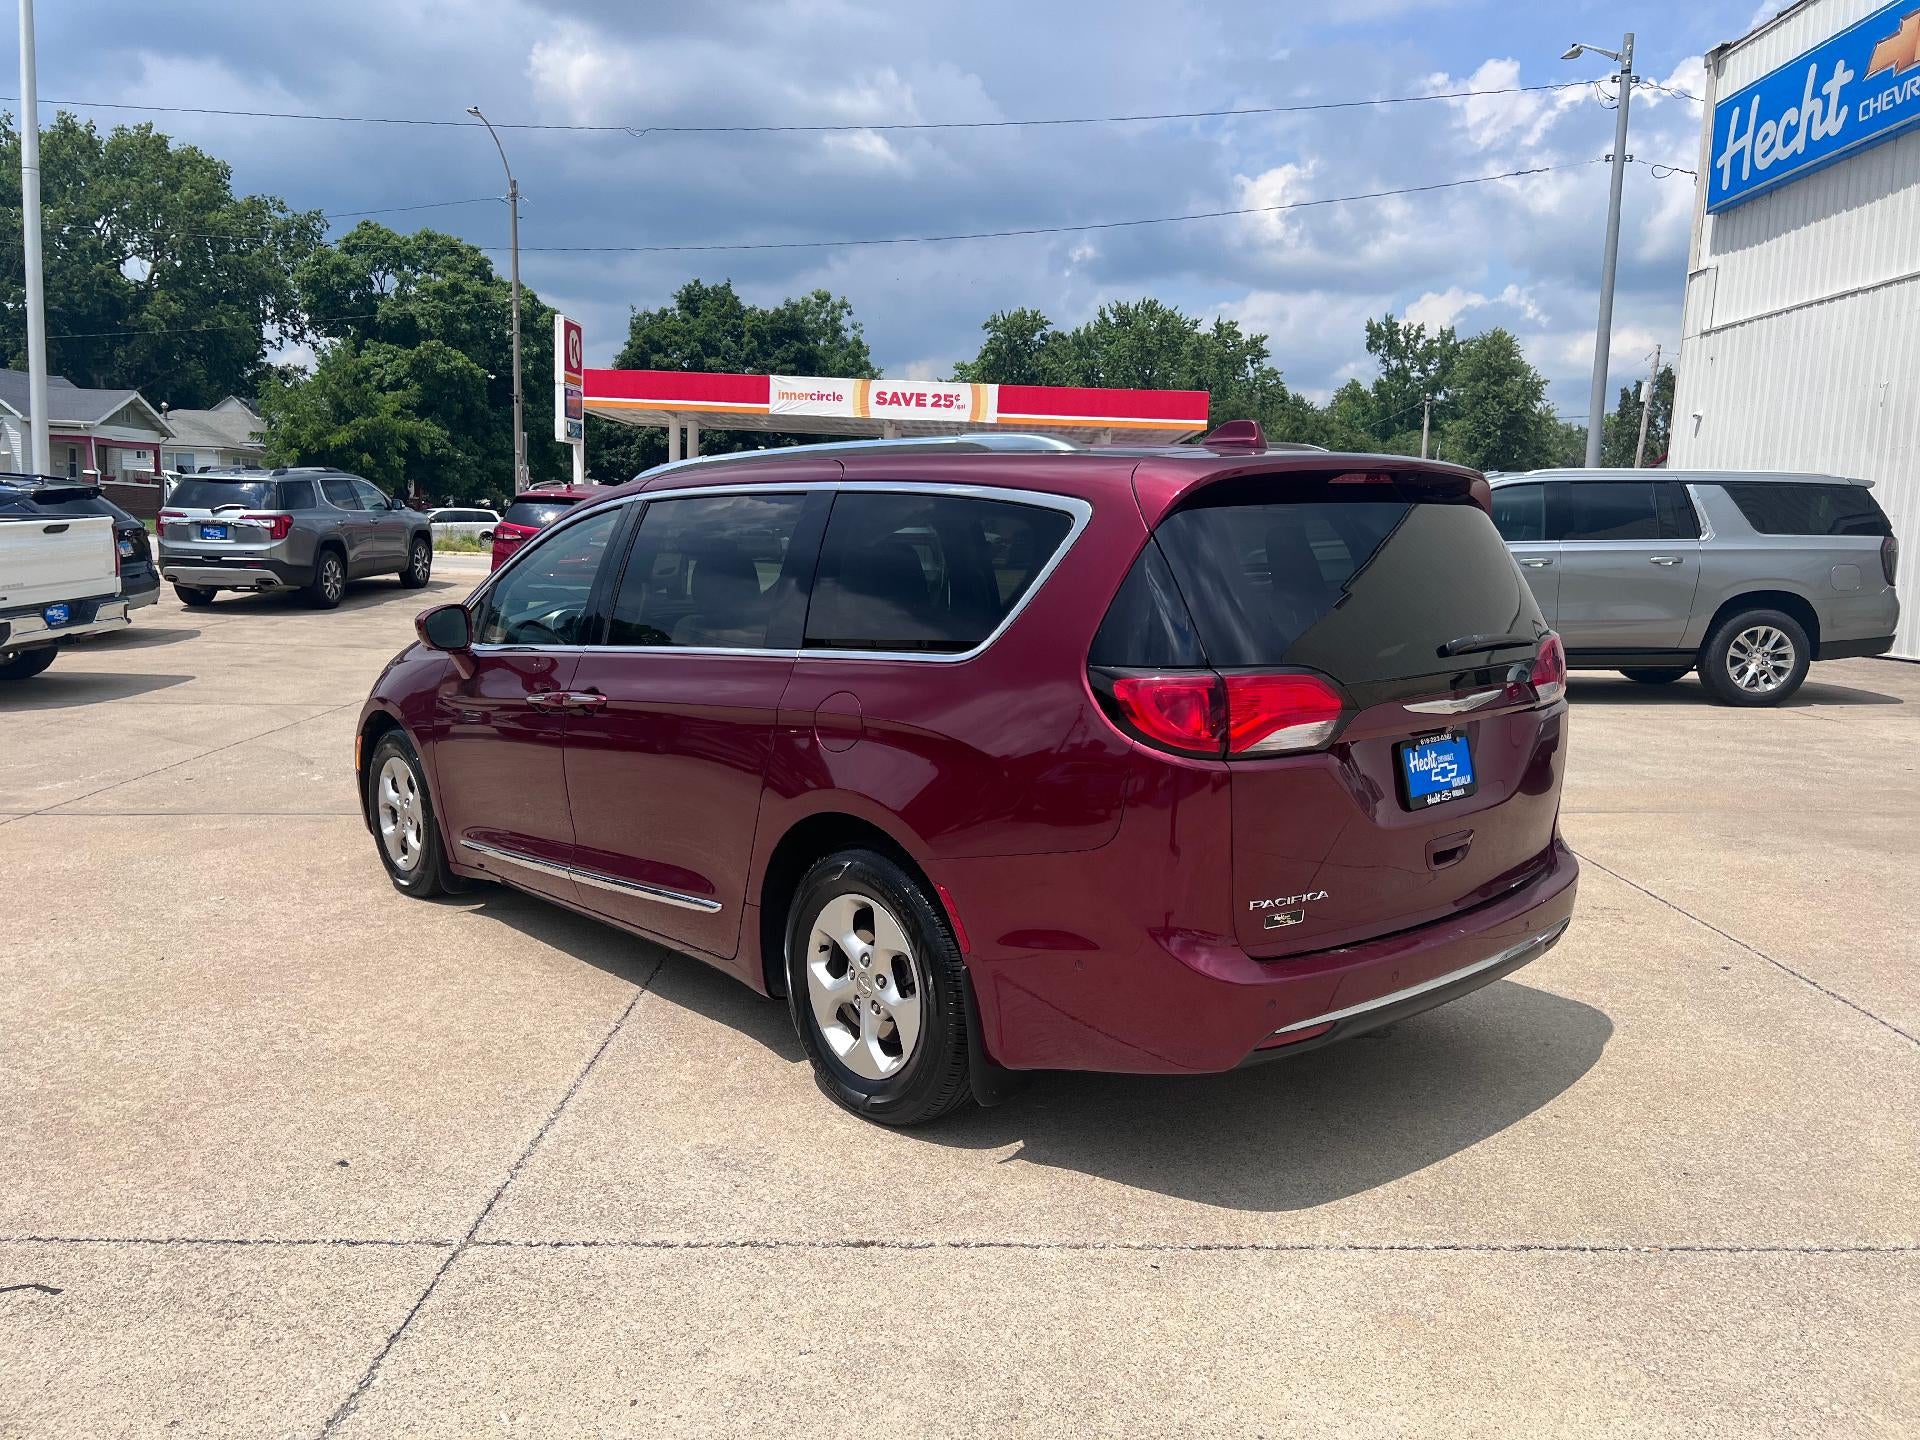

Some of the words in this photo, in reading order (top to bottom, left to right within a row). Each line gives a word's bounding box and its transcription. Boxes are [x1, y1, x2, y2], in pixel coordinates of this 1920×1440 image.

[1716, 60, 1855, 191] Hecht
[778, 390, 844, 402] innercircle
[875, 391, 927, 408] SAVE
[1409, 749, 1438, 774] Hecht
[1249, 890, 1329, 911] PACIFICA
